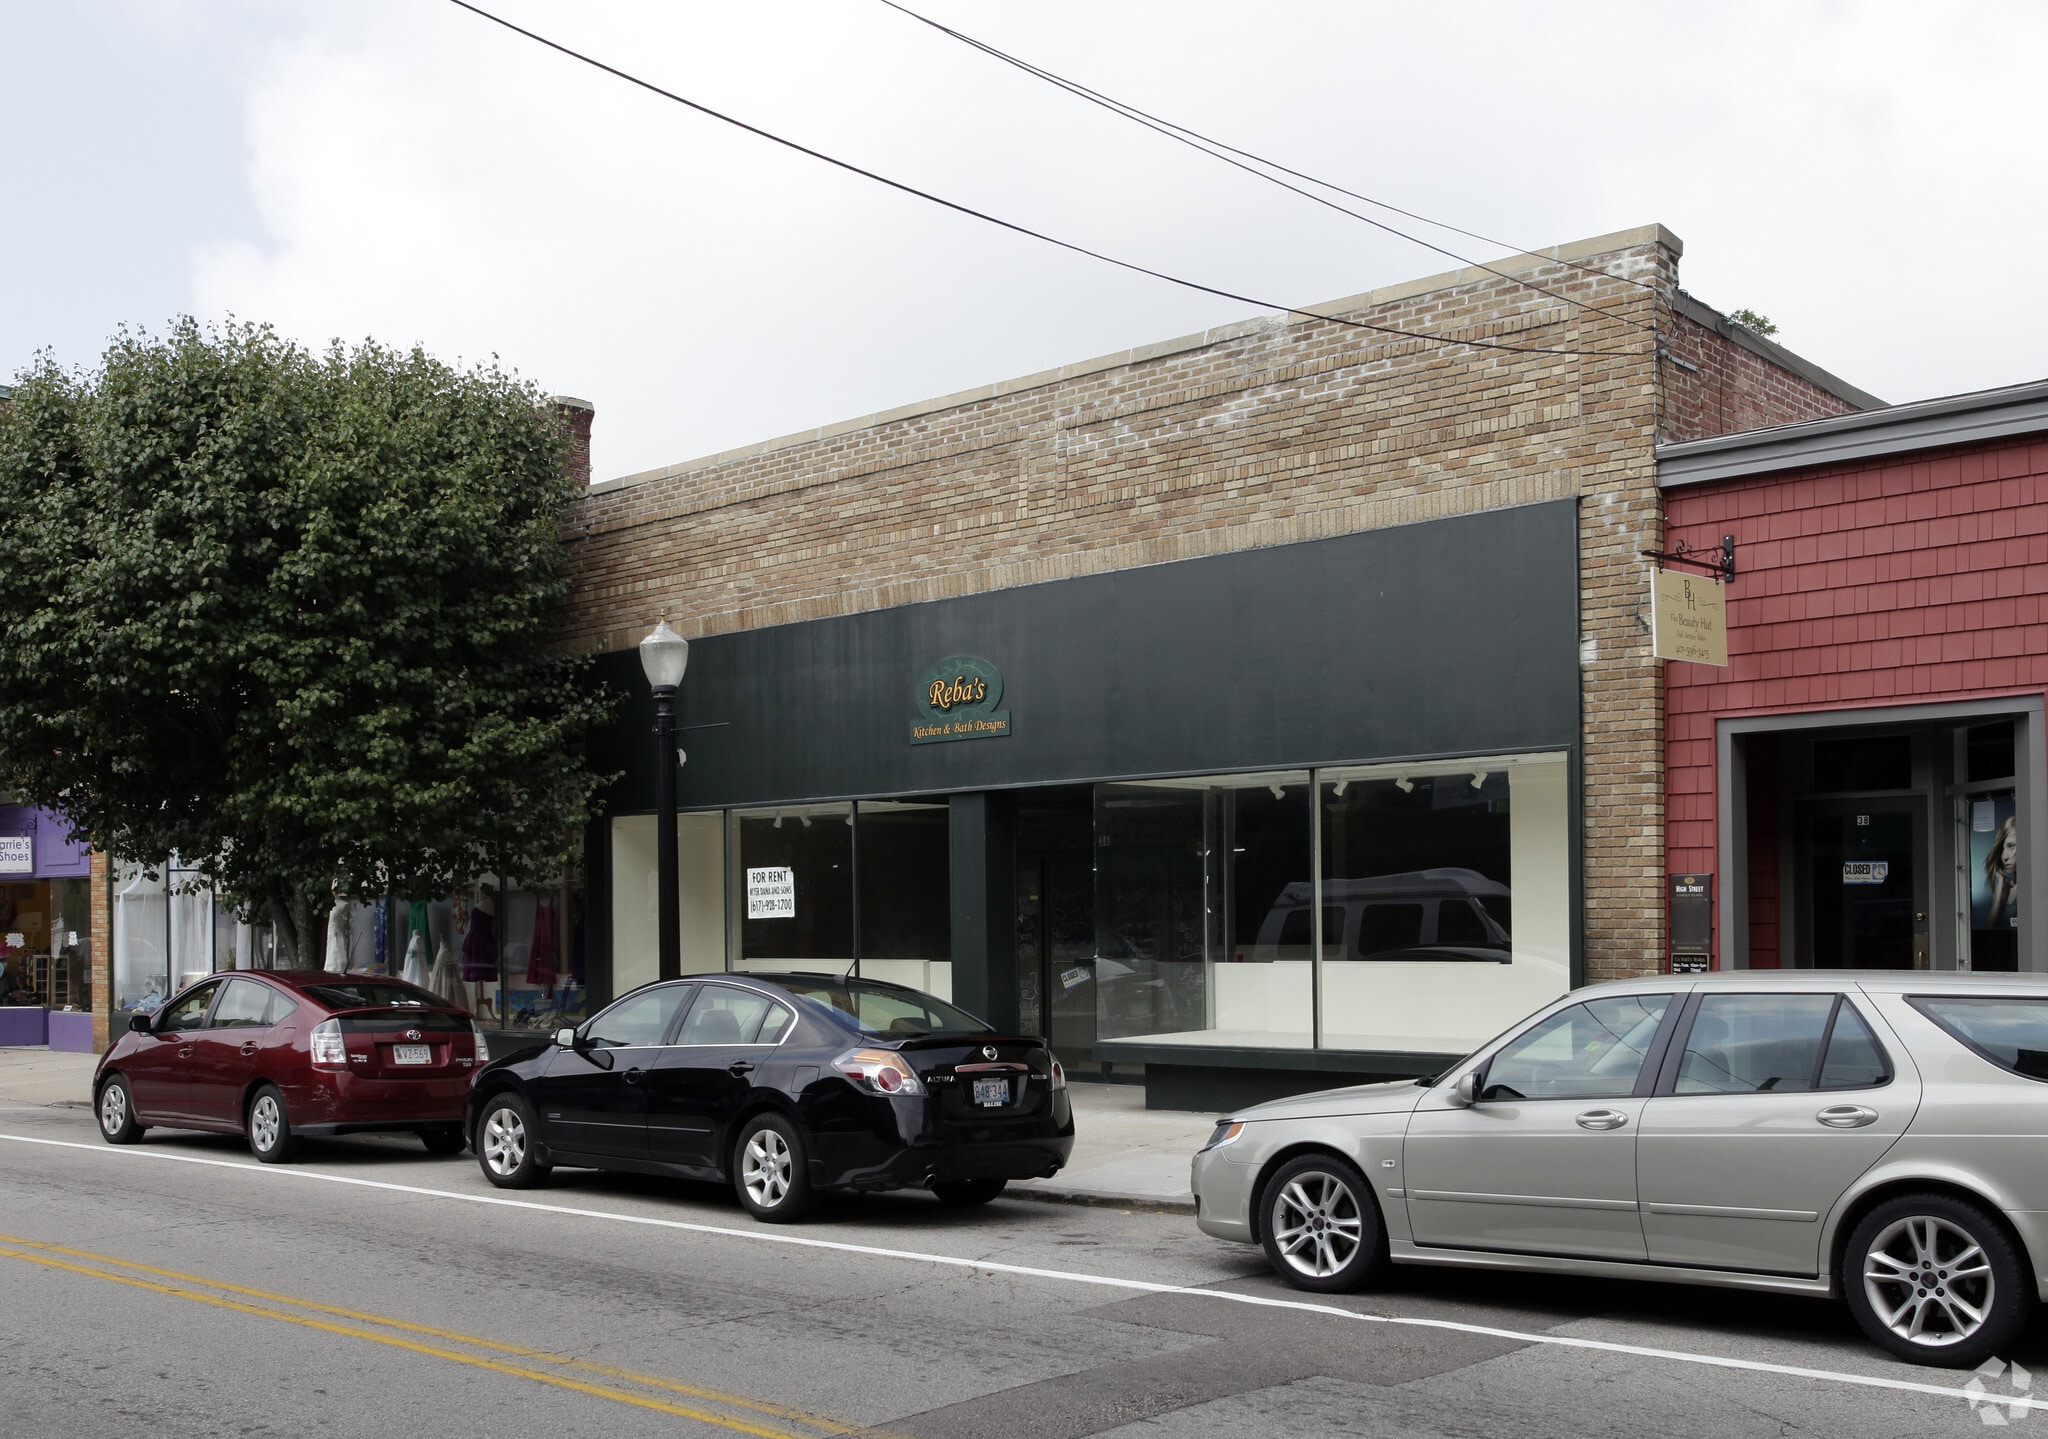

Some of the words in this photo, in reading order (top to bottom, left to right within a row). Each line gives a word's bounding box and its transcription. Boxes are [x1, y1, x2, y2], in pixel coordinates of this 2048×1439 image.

[1670, 613, 1678, 622] The
[1678, 613, 1699, 632] Beauty
[1700, 617, 1712, 630] Hut
[929, 675, 986, 709] Reba's
[913, 724, 942, 738] Kitchen
[943, 724, 951, 735] &
[953, 719, 973, 733] Bath
[975, 720, 1006, 734] Designs
[1858, 816, 1869, 825] 38
[0, 851, 29, 861] Shoes
[1844, 864, 1871, 875] CLOSED
[752, 872, 766, 883] FOR
[768, 870, 787, 882] RENT
[780, 886, 793, 895] SONS
[1688, 885, 1704, 893] STREET
[1062, 969, 1079, 983] CLOSED
[402, 1048, 429, 1059] VZ-569
[927, 1075, 956, 1083] ALTIMA
